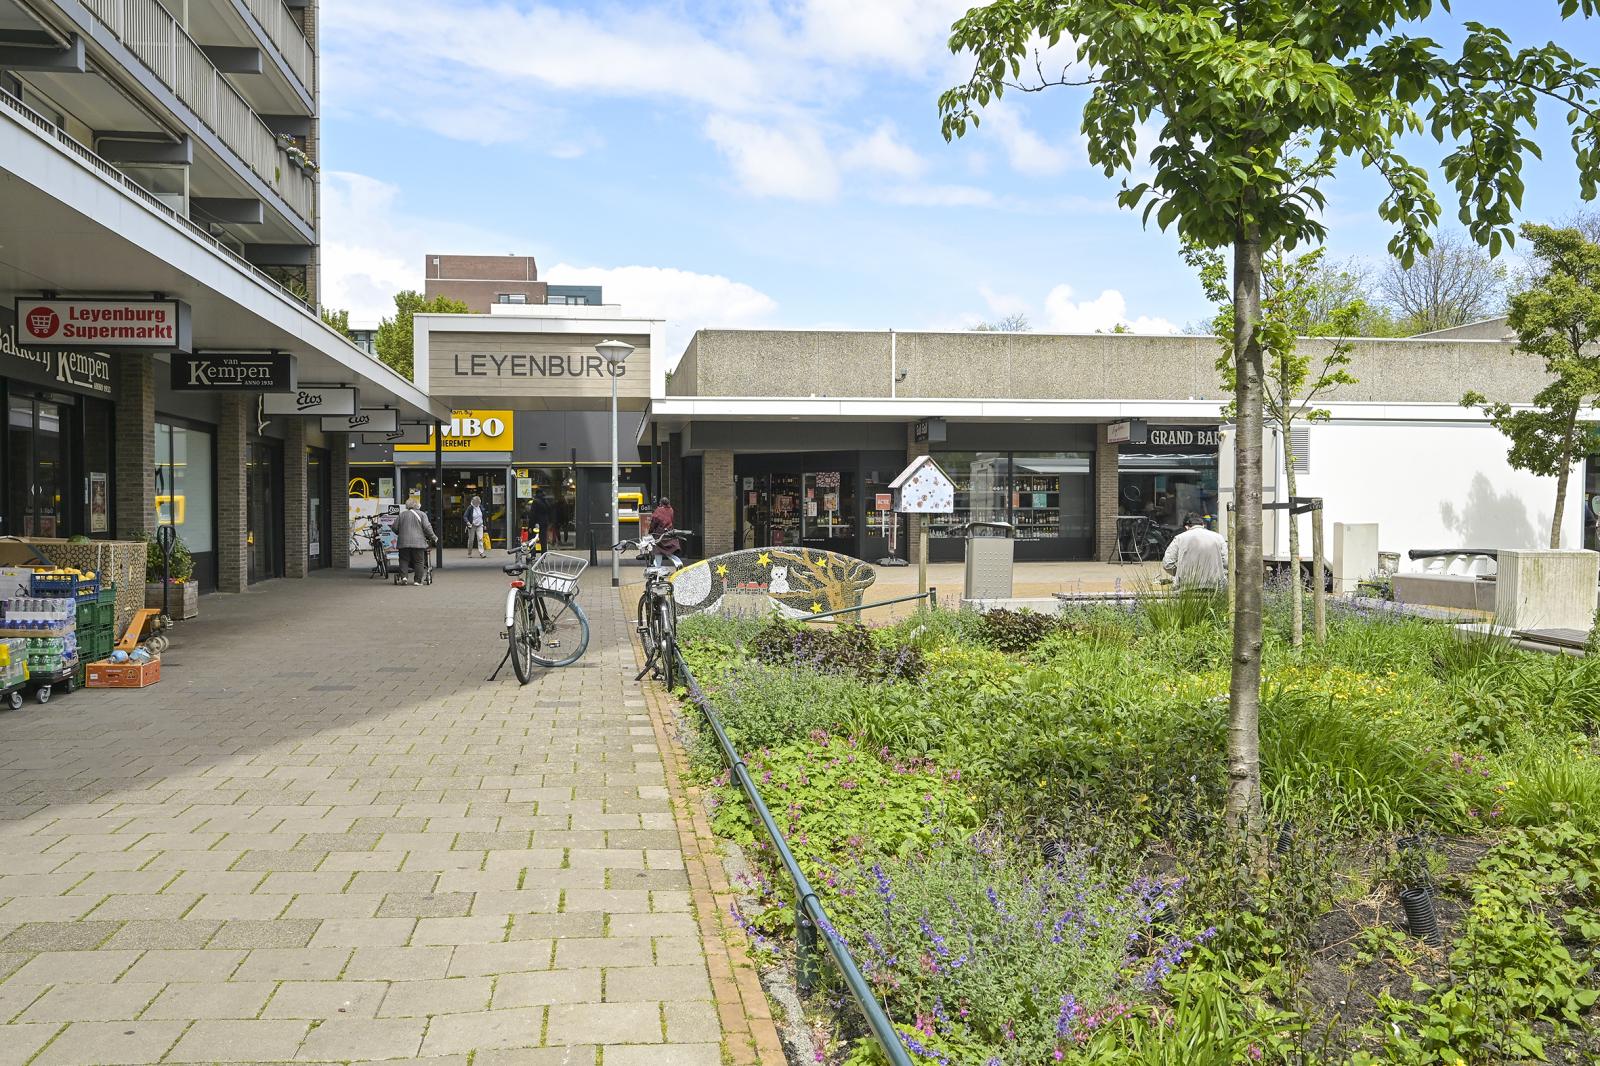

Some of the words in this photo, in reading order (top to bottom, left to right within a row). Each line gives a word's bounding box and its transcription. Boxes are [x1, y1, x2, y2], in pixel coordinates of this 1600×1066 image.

[69, 306, 166, 323] Leyenburg
[63, 323, 173, 339] Supermarkt
[223, 358, 238, 366] van
[187, 361, 271, 386] Kempen
[296, 391, 322, 407] Etos
[1150, 430, 1194, 446] GRAND
